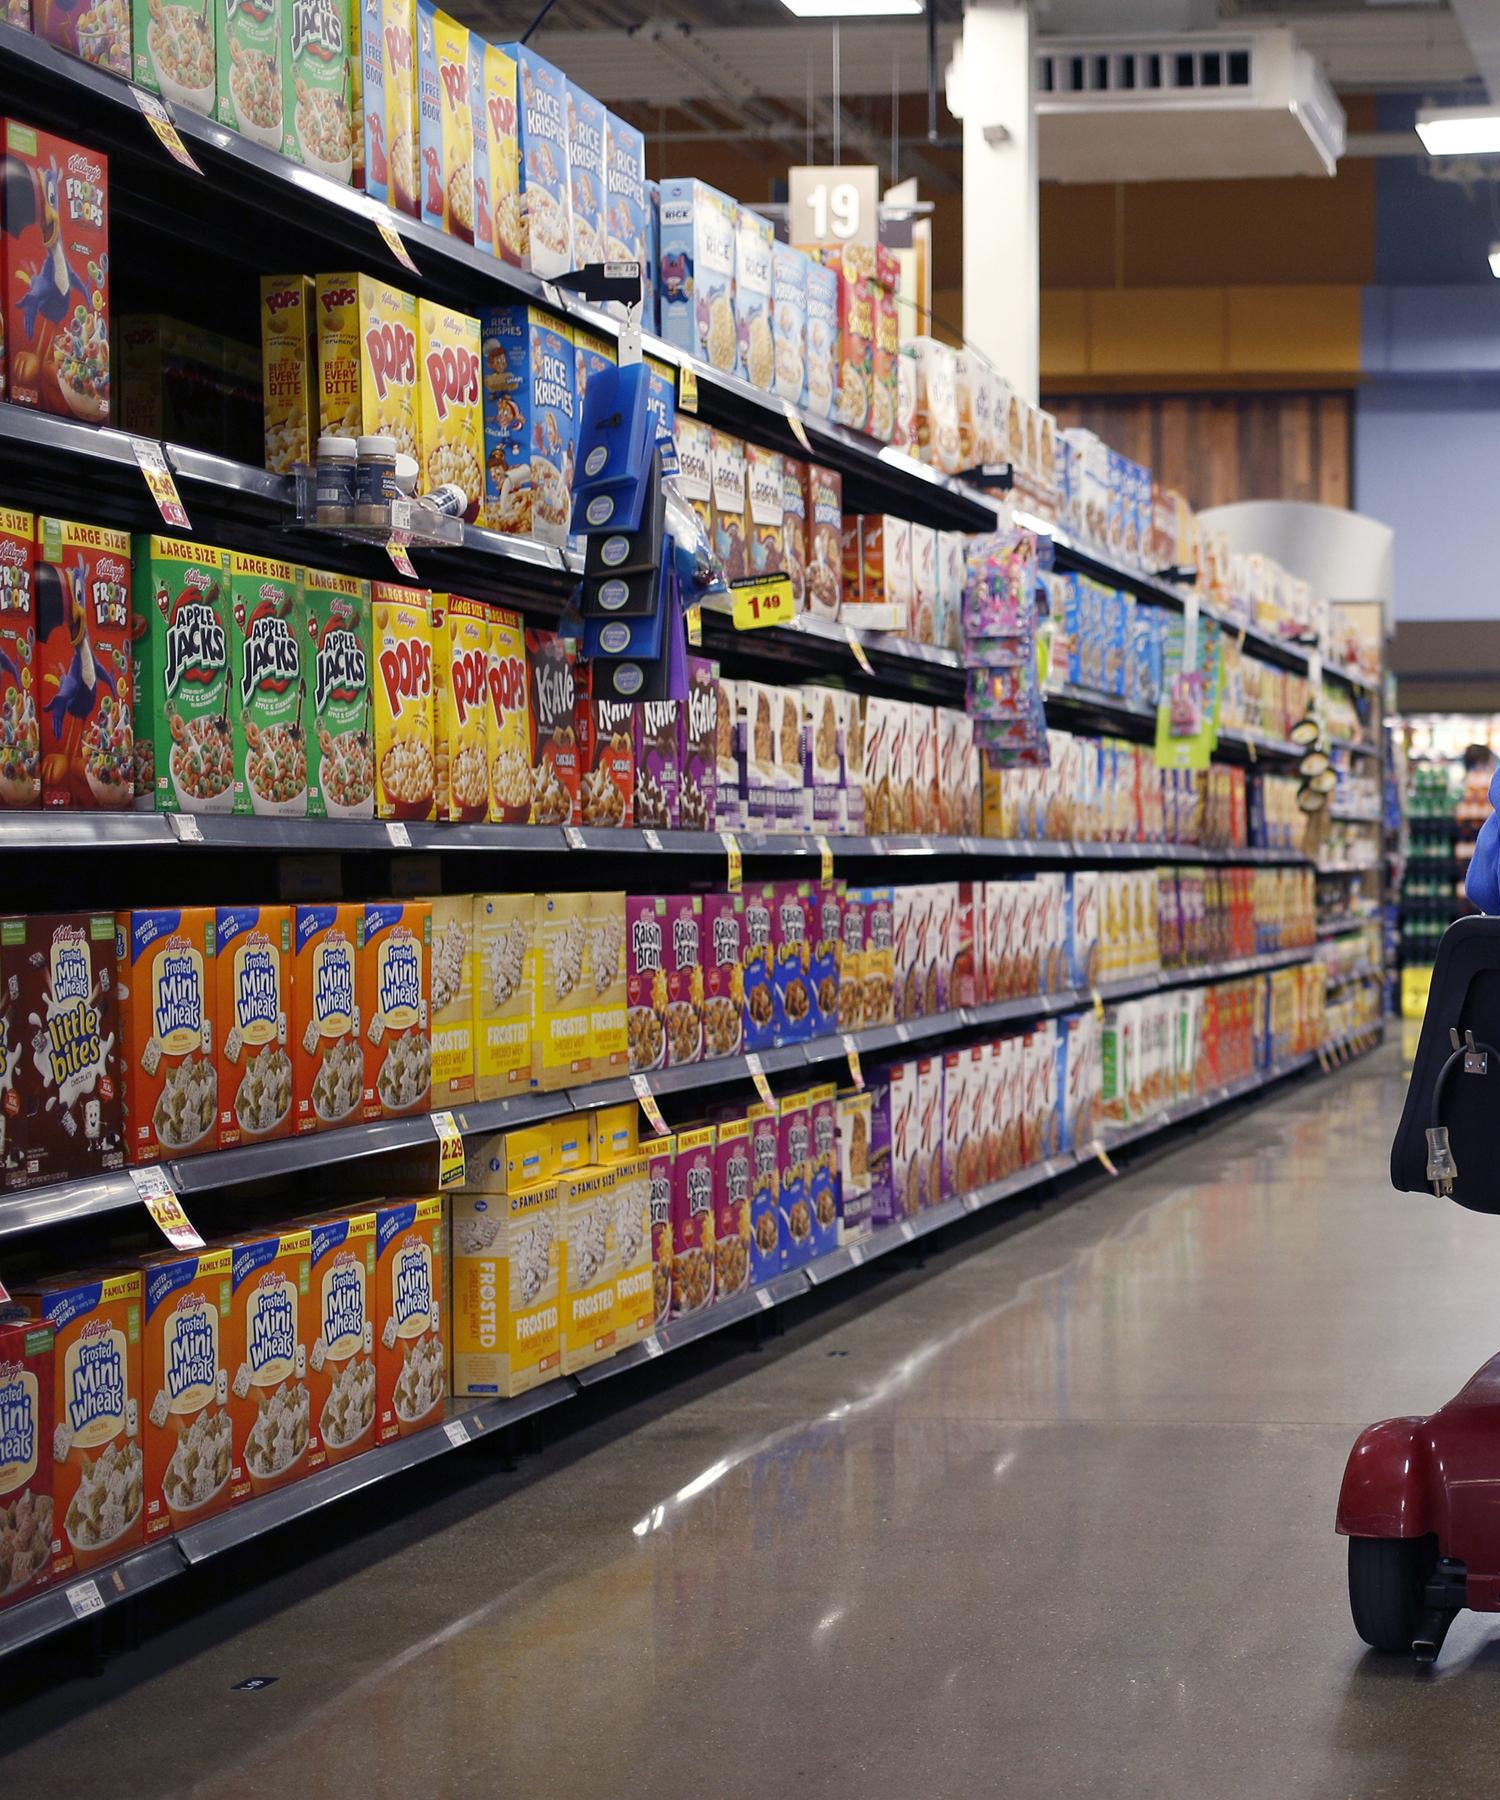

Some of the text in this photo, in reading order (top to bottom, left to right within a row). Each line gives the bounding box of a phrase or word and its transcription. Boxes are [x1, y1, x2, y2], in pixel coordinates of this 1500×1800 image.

[291, 5, 341, 58] JACKS
[369, 45, 382, 62] FREE
[365, 63, 383, 88] BOOK
[535, 89, 560, 123] RICE
[578, 122, 600, 153] RICE
[68, 154, 101, 182] Kellogg's
[616, 150, 638, 180] RICE
[65, 178, 104, 206] FROOT
[71, 199, 103, 227] LOOPS
[665, 210, 688, 219] RICE
[807, 183, 860, 239] 19
[705, 236, 730, 260] RICE
[265, 291, 300, 315] POPS
[320, 288, 356, 313] POPS
[483, 325, 522, 337] KRISPIES
[491, 316, 512, 327] RICE
[324, 361, 357, 371] BEST IN
[366, 321, 416, 400] POPS
[543, 353, 567, 385] RICE
[325, 370, 356, 381] EVERY
[325, 381, 357, 395] BITE
[425, 346, 480, 421] POPS
[534, 379, 574, 420] KRISPIES
[680, 453, 706, 477] COCOA
[148, 475, 175, 497] 2.99
[717, 467, 740, 489] COCOA
[67, 529, 127, 550] LARGE SIZE
[159, 541, 217, 565] LARGE SIZE
[96, 557, 125, 581] Kellogg's
[184, 567, 211, 591] Kellogg's
[236, 556, 291, 580] LARGE SIZE
[92, 580, 127, 604] FROOT
[308, 573, 358, 593] LARGE SIZE
[377, 588, 422, 606] LARGE SIZE
[748, 595, 780, 619] 1 49
[97, 602, 128, 627] LOOPS
[176, 604, 214, 630] APPLE
[252, 617, 288, 641] APPLE
[324, 631, 356, 653] APPLE
[166, 626, 224, 697] JACKS
[242, 637, 298, 707] JACKS
[316, 650, 366, 713] JACKS
[379, 638, 432, 719] POPS
[452, 649, 488, 728] POPS
[489, 656, 525, 729] POPS
[53, 924, 86, 945] Kellogg's
[165, 935, 192, 954] Kellogg's
[633, 922, 661, 949] Raisin
[59, 949, 81, 963] Frosted
[165, 957, 192, 974] Frosted
[637, 948, 660, 974] Bran
[56, 961, 86, 984] Mini
[240, 968, 275, 998] Mini
[384, 960, 417, 987] Mini
[55, 978, 89, 1002] Wheats
[160, 973, 198, 1003] Mini
[382, 982, 418, 1013] Wheats
[48, 1001, 97, 1044] little
[157, 999, 200, 1036] Wheats
[238, 996, 277, 1028] Wheats
[487, 1023, 529, 1047] FROSTED
[49, 1034, 99, 1088] bites
[70, 1072, 92, 1087] CHOCOLATE
[442, 1139, 463, 1160] 2.29
[577, 1175, 615, 1195] FAMILY SIZE
[688, 1168, 711, 1193] Raisin
[519, 1186, 559, 1209] FAMILY SIZE
[691, 1192, 711, 1217] Bran
[152, 1200, 182, 1224] 2.99
[199, 1257, 231, 1273] FAMILY SIZE
[103, 1280, 140, 1298] FAMILY SIZE
[479, 1262, 496, 1348] FROSTED
[81, 1319, 111, 1341] Kellogg's
[516, 1308, 557, 1340] FROSTED
[80, 1341, 112, 1364] Frosted
[172, 1329, 212, 1363] Mini
[73, 1353, 120, 1394] Mini
[168, 1358, 215, 1398] Wheats
[70, 1387, 123, 1431] Wheats
